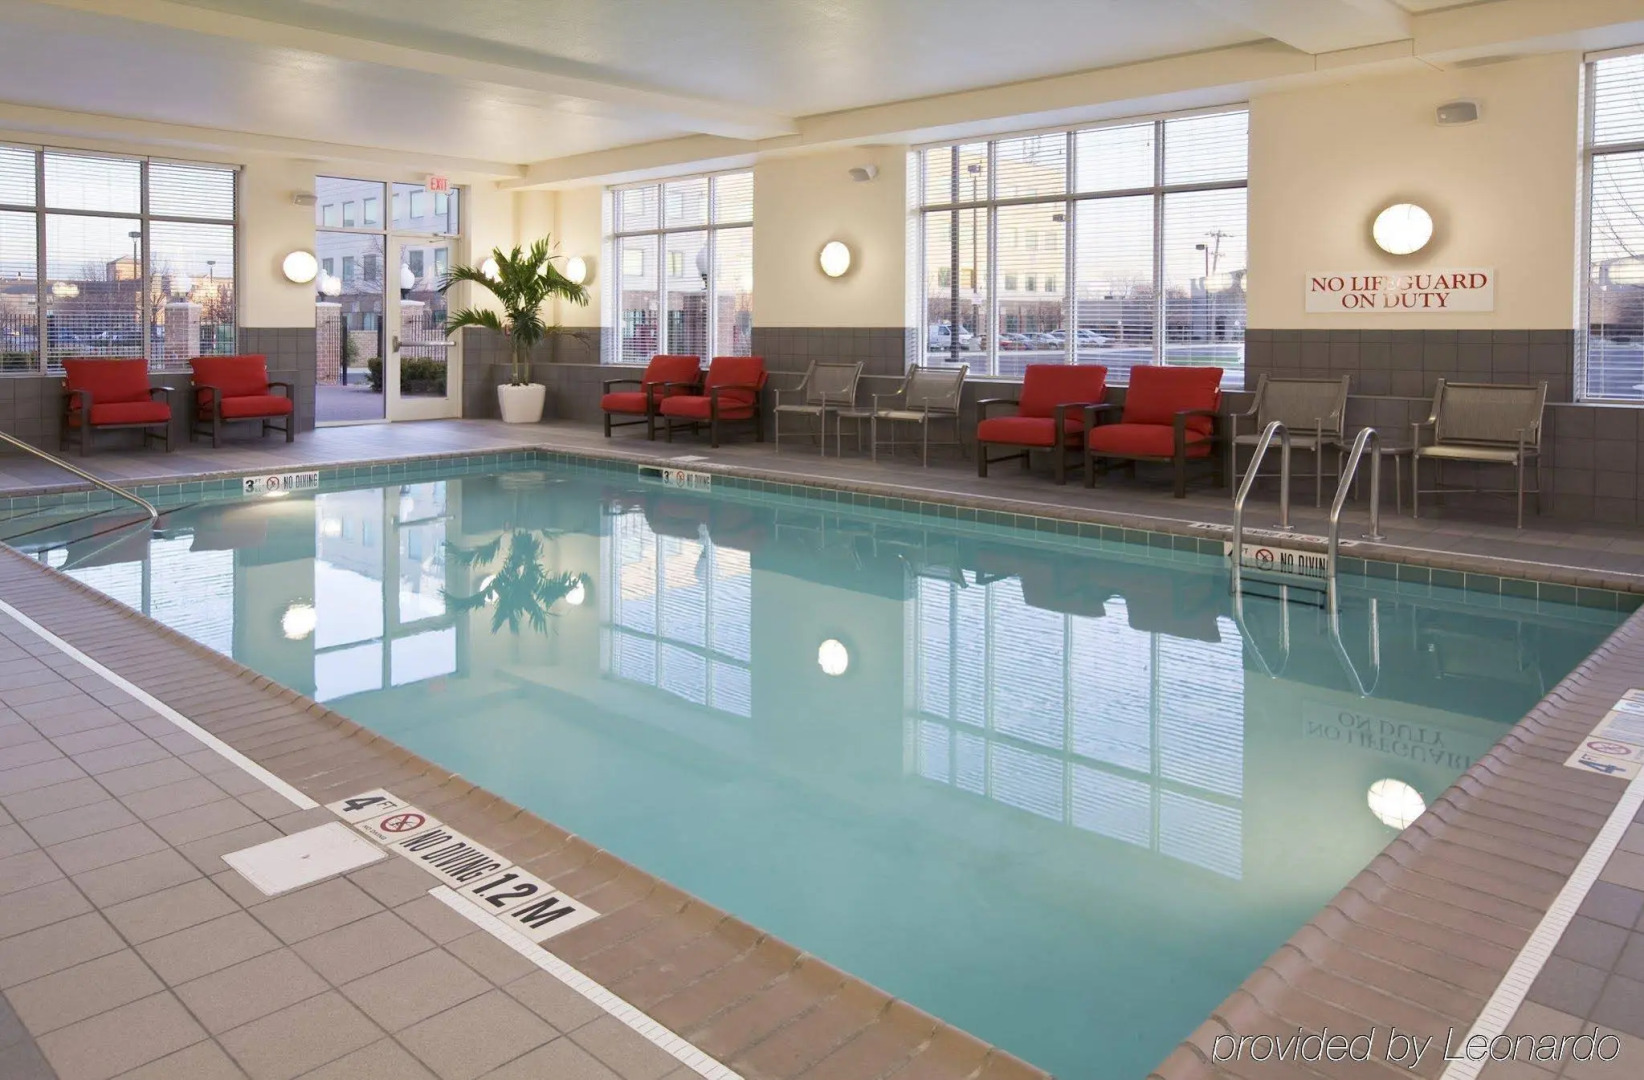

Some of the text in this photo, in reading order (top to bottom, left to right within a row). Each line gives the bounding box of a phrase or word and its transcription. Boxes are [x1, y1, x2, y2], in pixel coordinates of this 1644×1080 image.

[431, 177, 448, 191] EXIT
[1311, 273, 1488, 292] NO LIFGUARD
[1342, 292, 1450, 309] ON DUTY
[245, 479, 255, 492] 3
[283, 475, 293, 490] NO
[1280, 552, 1294, 572] NO
[1298, 554, 1329, 577] DIVIN
[342, 796, 398, 813] 4 FT
[399, 828, 453, 852] NO
[422, 842, 501, 884] DIVING
[511, 897, 577, 930] M
